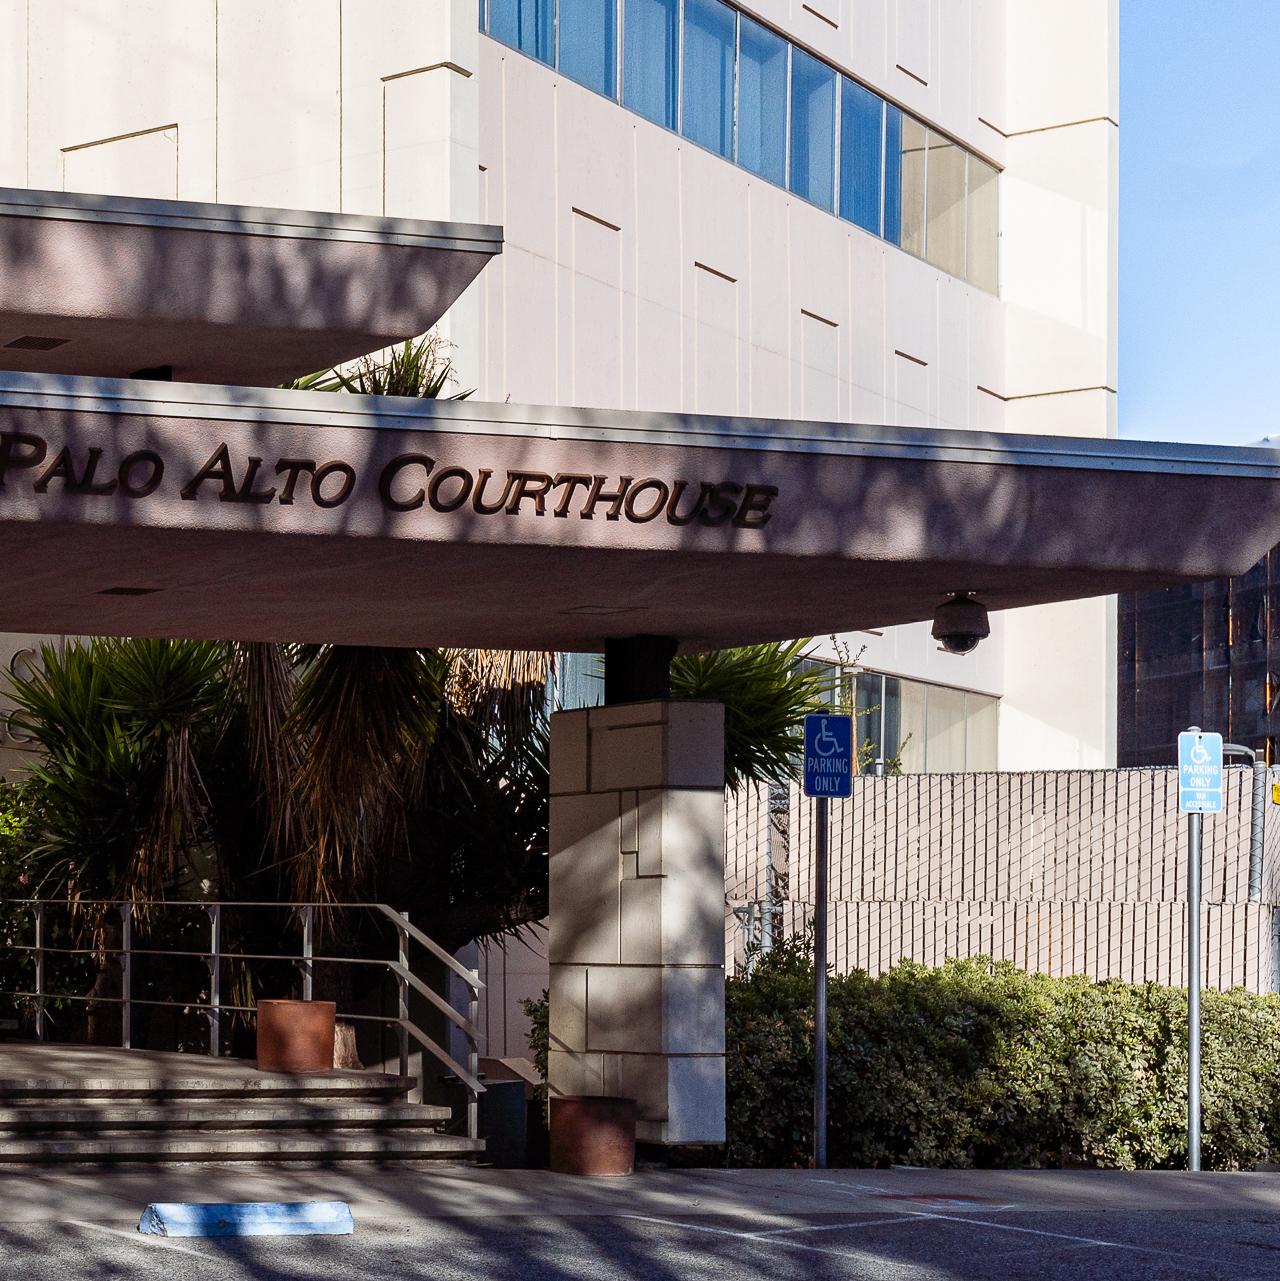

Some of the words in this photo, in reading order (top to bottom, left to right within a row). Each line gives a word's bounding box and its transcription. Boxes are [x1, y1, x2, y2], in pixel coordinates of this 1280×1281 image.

[180, 442, 355, 508] ALTO
[379, 453, 779, 529] COURTHOUSE
[808, 757, 848, 774] PARKING
[1183, 765, 1218, 774] PARKING
[815, 776, 840, 792] ONLY
[1190, 778, 1210, 786] ONLY
